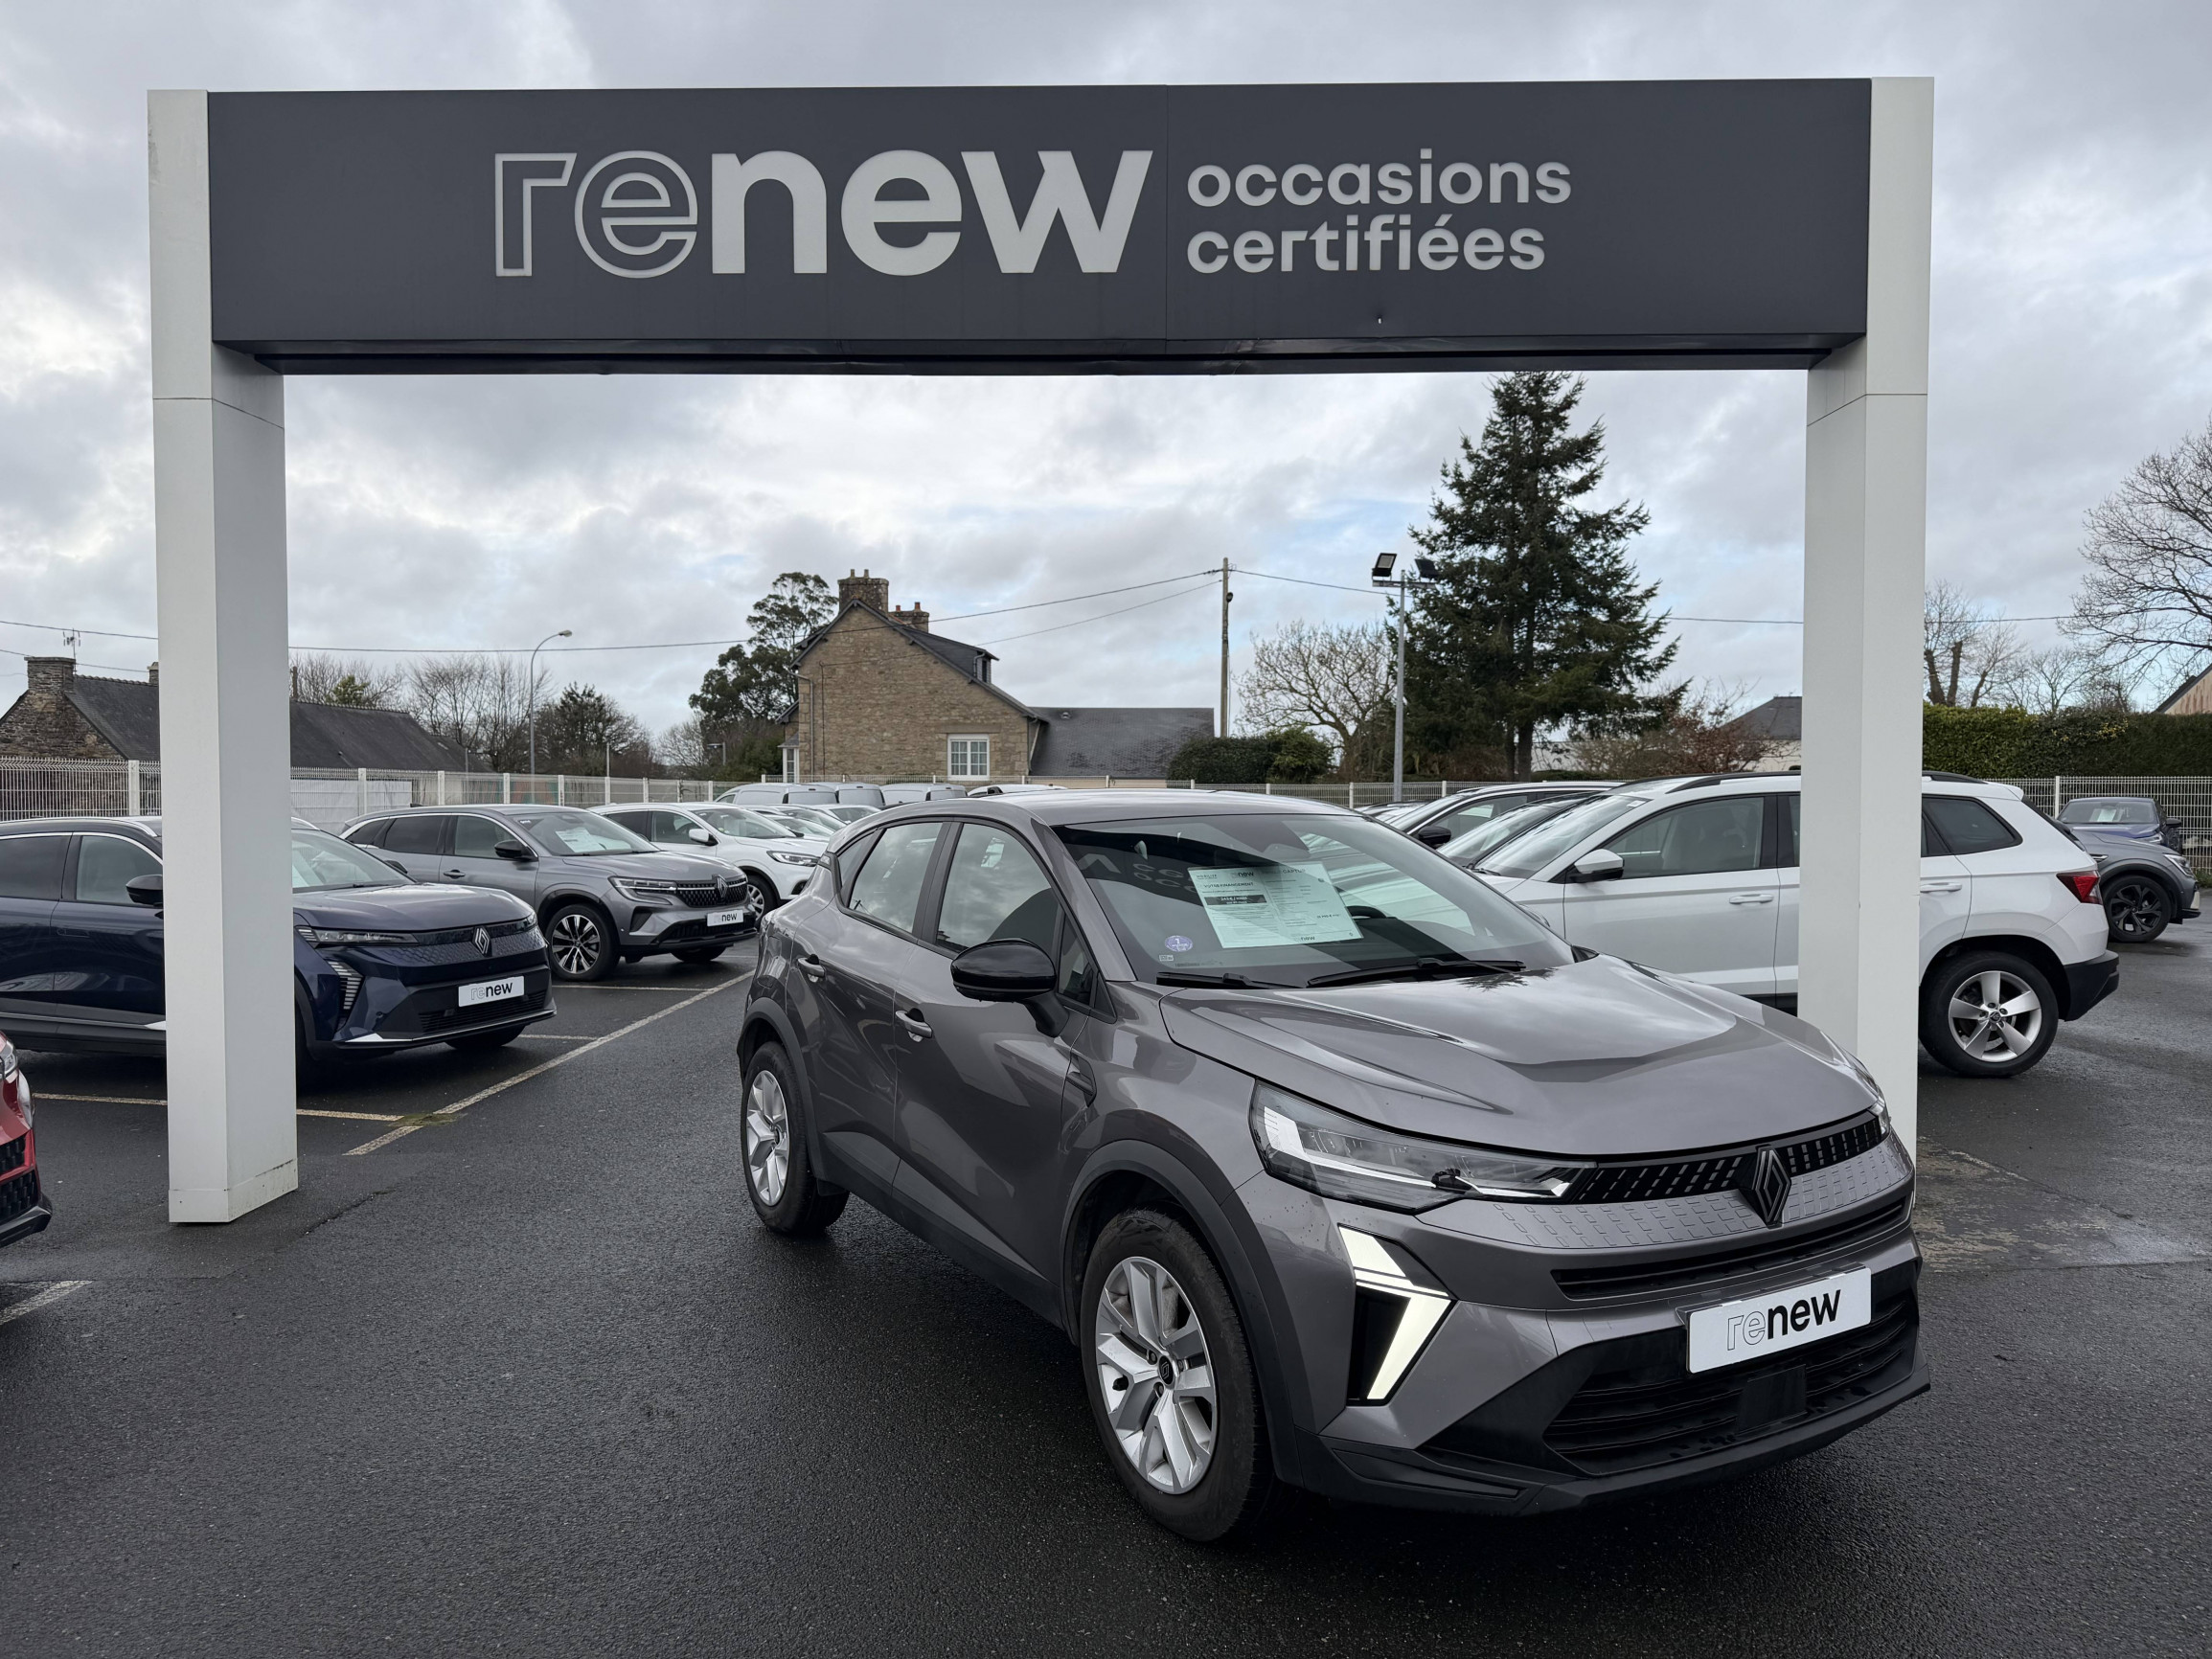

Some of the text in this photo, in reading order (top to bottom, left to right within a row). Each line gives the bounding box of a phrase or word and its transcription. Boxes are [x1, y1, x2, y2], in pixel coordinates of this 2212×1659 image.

[1187, 148, 1572, 208] occasions
[494, 149, 1153, 279] renew
[1187, 214, 1546, 274] certifiées
[714, 913, 738, 923] new
[470, 982, 513, 1001] renew
[1726, 1288, 1841, 1352] renew
